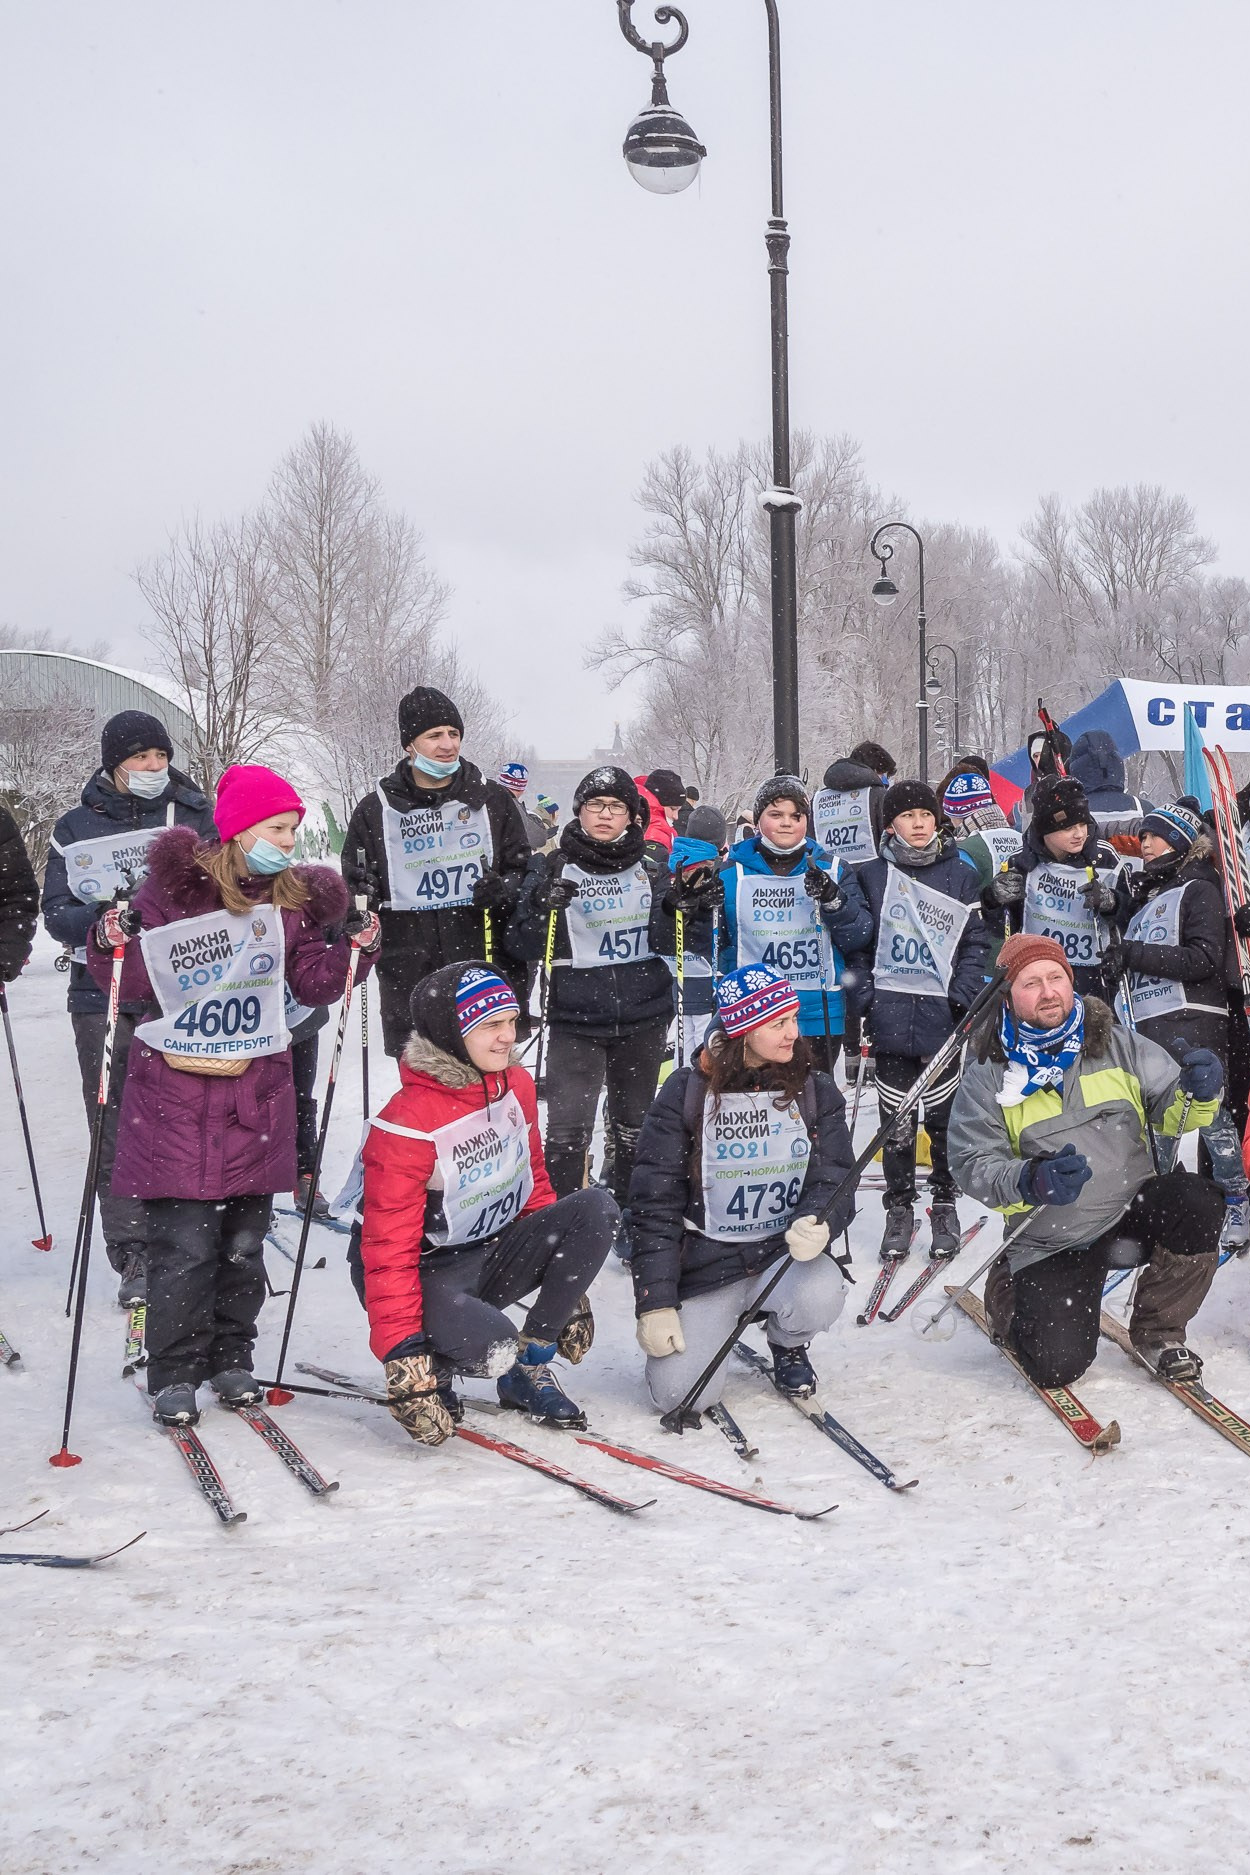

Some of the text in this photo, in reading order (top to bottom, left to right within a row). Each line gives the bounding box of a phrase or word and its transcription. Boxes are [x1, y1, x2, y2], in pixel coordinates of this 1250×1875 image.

[400, 810, 442, 828] ЛЫЖНЯ
[401, 822, 444, 839] РОССИИ
[825, 825, 858, 847] 4827
[404, 835, 442, 854] 2021
[416, 863, 480, 900] 4973
[579, 877, 620, 889] ЛЫЖНЯ
[580, 886, 623, 899] РОССИИ
[752, 887, 795, 898] ЛЫЖНЯ
[1037, 883, 1076, 900] РОССИИ
[582, 897, 624, 914] 2021
[752, 898, 795, 908] РОССИИ
[1035, 894, 1071, 912] 2021
[753, 910, 792, 922] 2021
[168, 929, 230, 959] ЛЫЖНЯ
[676, 919, 684, 973] LARSEN
[1041, 928, 1093, 960] 83
[171, 943, 234, 973] РОССИИ
[762, 939, 820, 970] 4653
[784, 969, 829, 981] ПЕТЕРБУГ
[174, 995, 261, 1037] 4609
[164, 1035, 274, 1054] САНКТ-ПЕТЕРБУРГ
[714, 1110, 769, 1128] ЛЫЖНЯ
[715, 1125, 771, 1141] РОССИИ
[452, 1127, 500, 1162] ЛЫЖНЯ
[716, 1140, 769, 1160] 2021
[455, 1139, 503, 1175] РОССИИ
[458, 1160, 501, 1191] 2021
[715, 1169, 744, 1181] СПОРТ
[750, 1165, 786, 1177] НОРМА
[459, 1192, 484, 1210] СПОРТ
[726, 1176, 802, 1221] 4736
[466, 1181, 524, 1239] 4791
